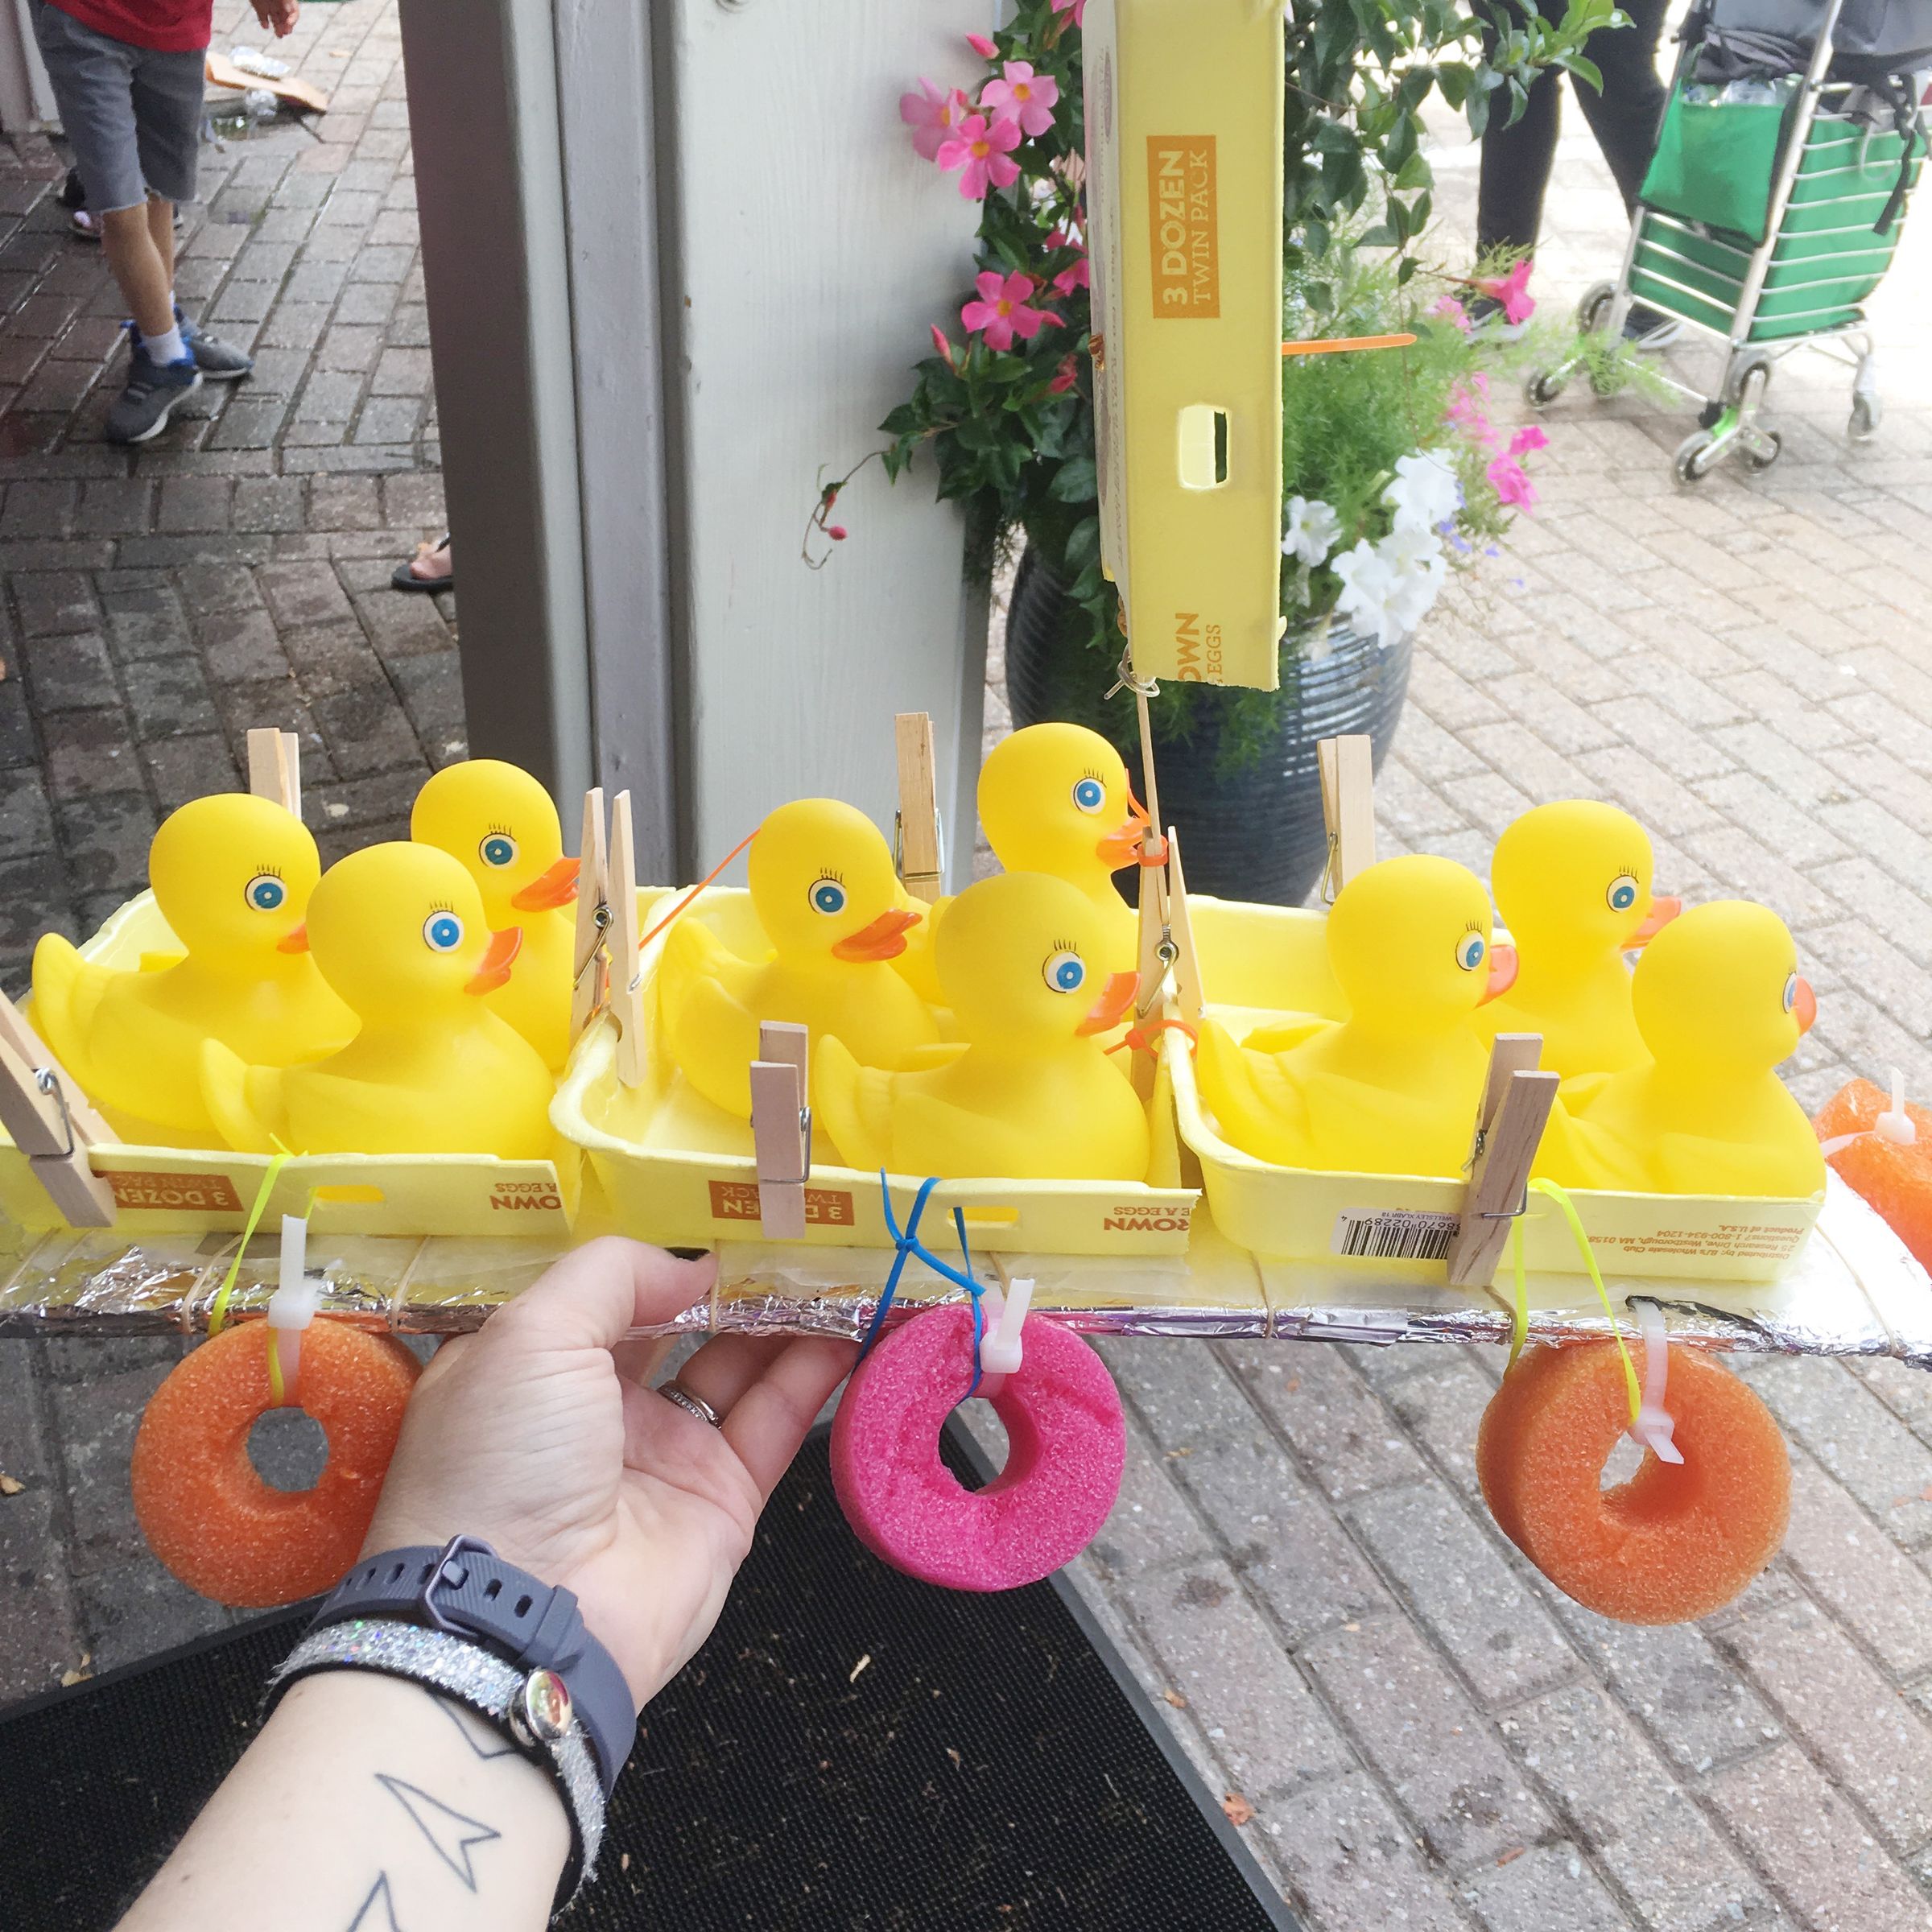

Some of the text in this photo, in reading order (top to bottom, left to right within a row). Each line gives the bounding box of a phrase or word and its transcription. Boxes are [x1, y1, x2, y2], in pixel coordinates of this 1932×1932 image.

[1158, 151, 1187, 305] 3 DOZEN
[1190, 149, 1211, 304] TWIN PACK
[1206, 625, 1222, 675] EGGS
[111, 1176, 155, 1187] PAC
[494, 1183, 543, 1192] EGGS
[721, 1187, 759, 1198] ACK
[213, 1191, 229, 1206] 3
[489, 1195, 561, 1210] OWN
[723, 1199, 842, 1220] 3 DEN
[1114, 1207, 1161, 1216] EGGS
[1164, 1208, 1178, 1216] A
[1364, 1217, 1411, 1228] 02289
[1657, 1230, 1799, 1243] Questions? 1-800-934-1204
[1764, 1227, 1804, 1235] Product
[1639, 1238, 1701, 1247] Westborough,
[1705, 1241, 1731, 1249] Drive,
[1737, 1251, 1790, 1260] Distributed
